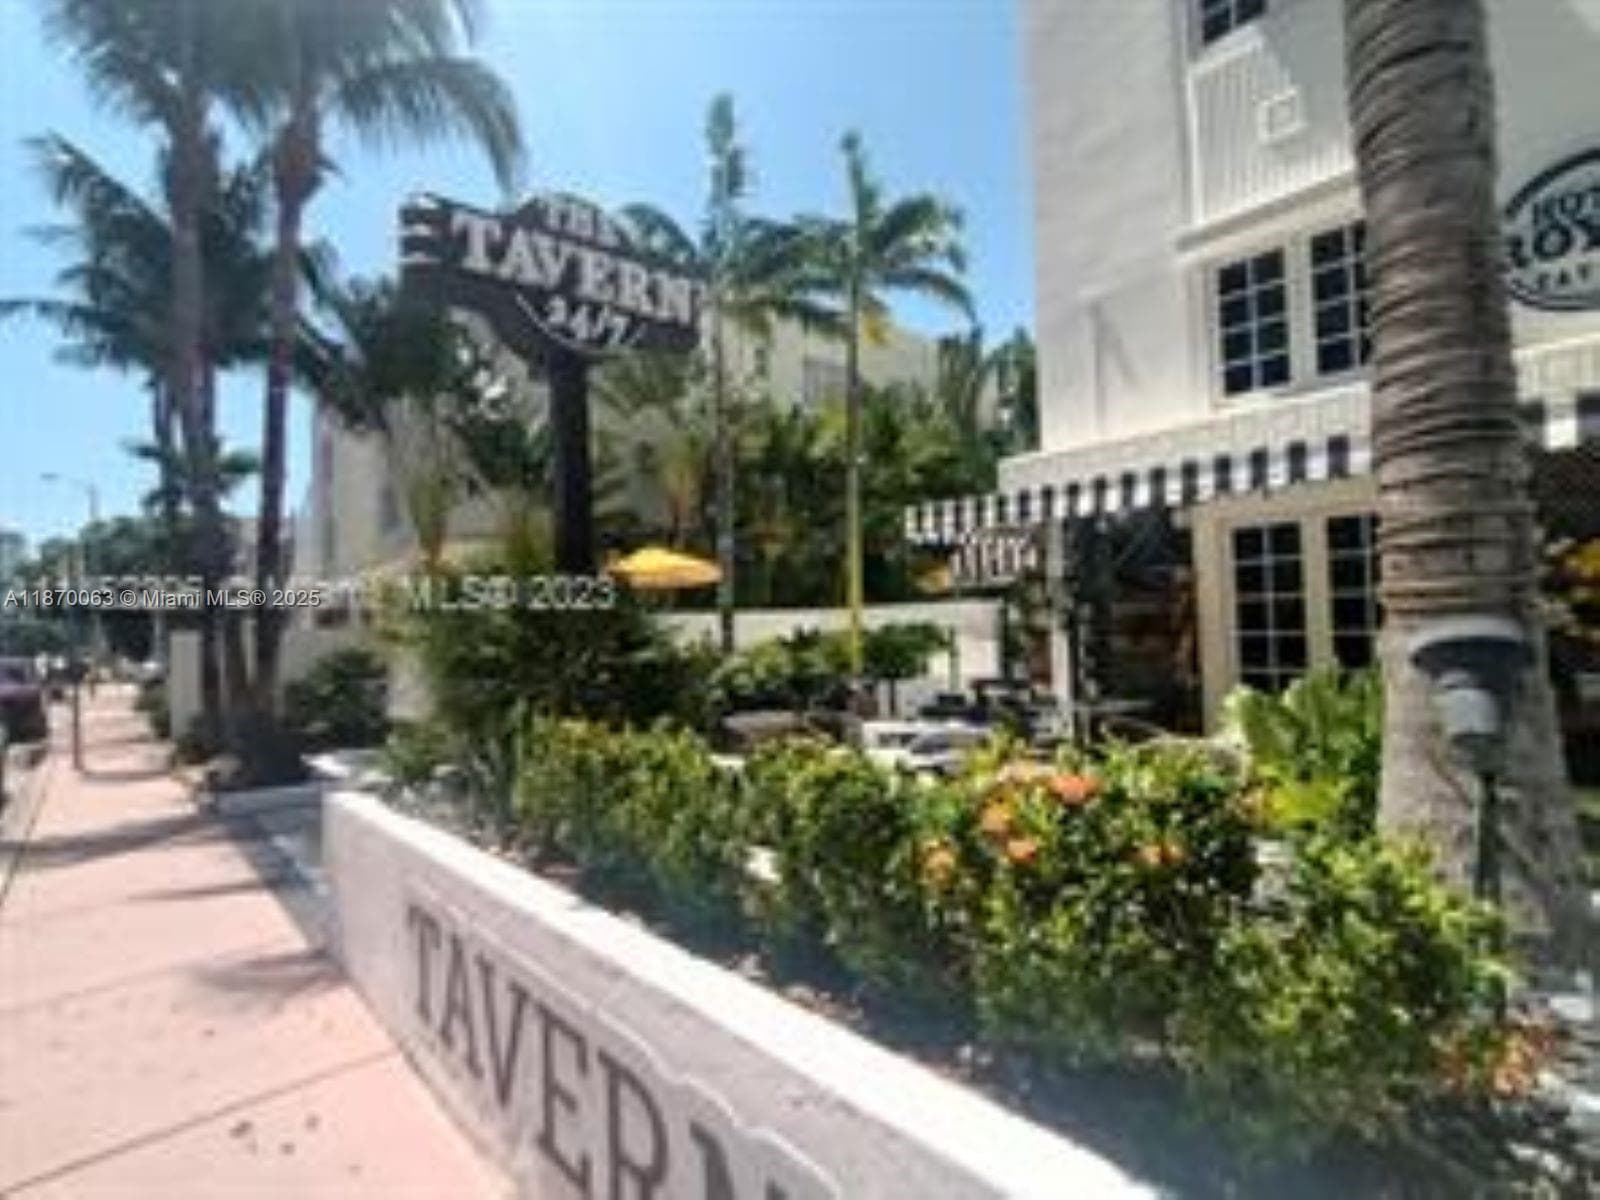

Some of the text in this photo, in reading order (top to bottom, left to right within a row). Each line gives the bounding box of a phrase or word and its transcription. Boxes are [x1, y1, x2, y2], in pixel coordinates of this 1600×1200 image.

[542, 200, 620, 248] THE
[452, 209, 704, 328] TAVERN
[544, 296, 630, 343] 24/7
